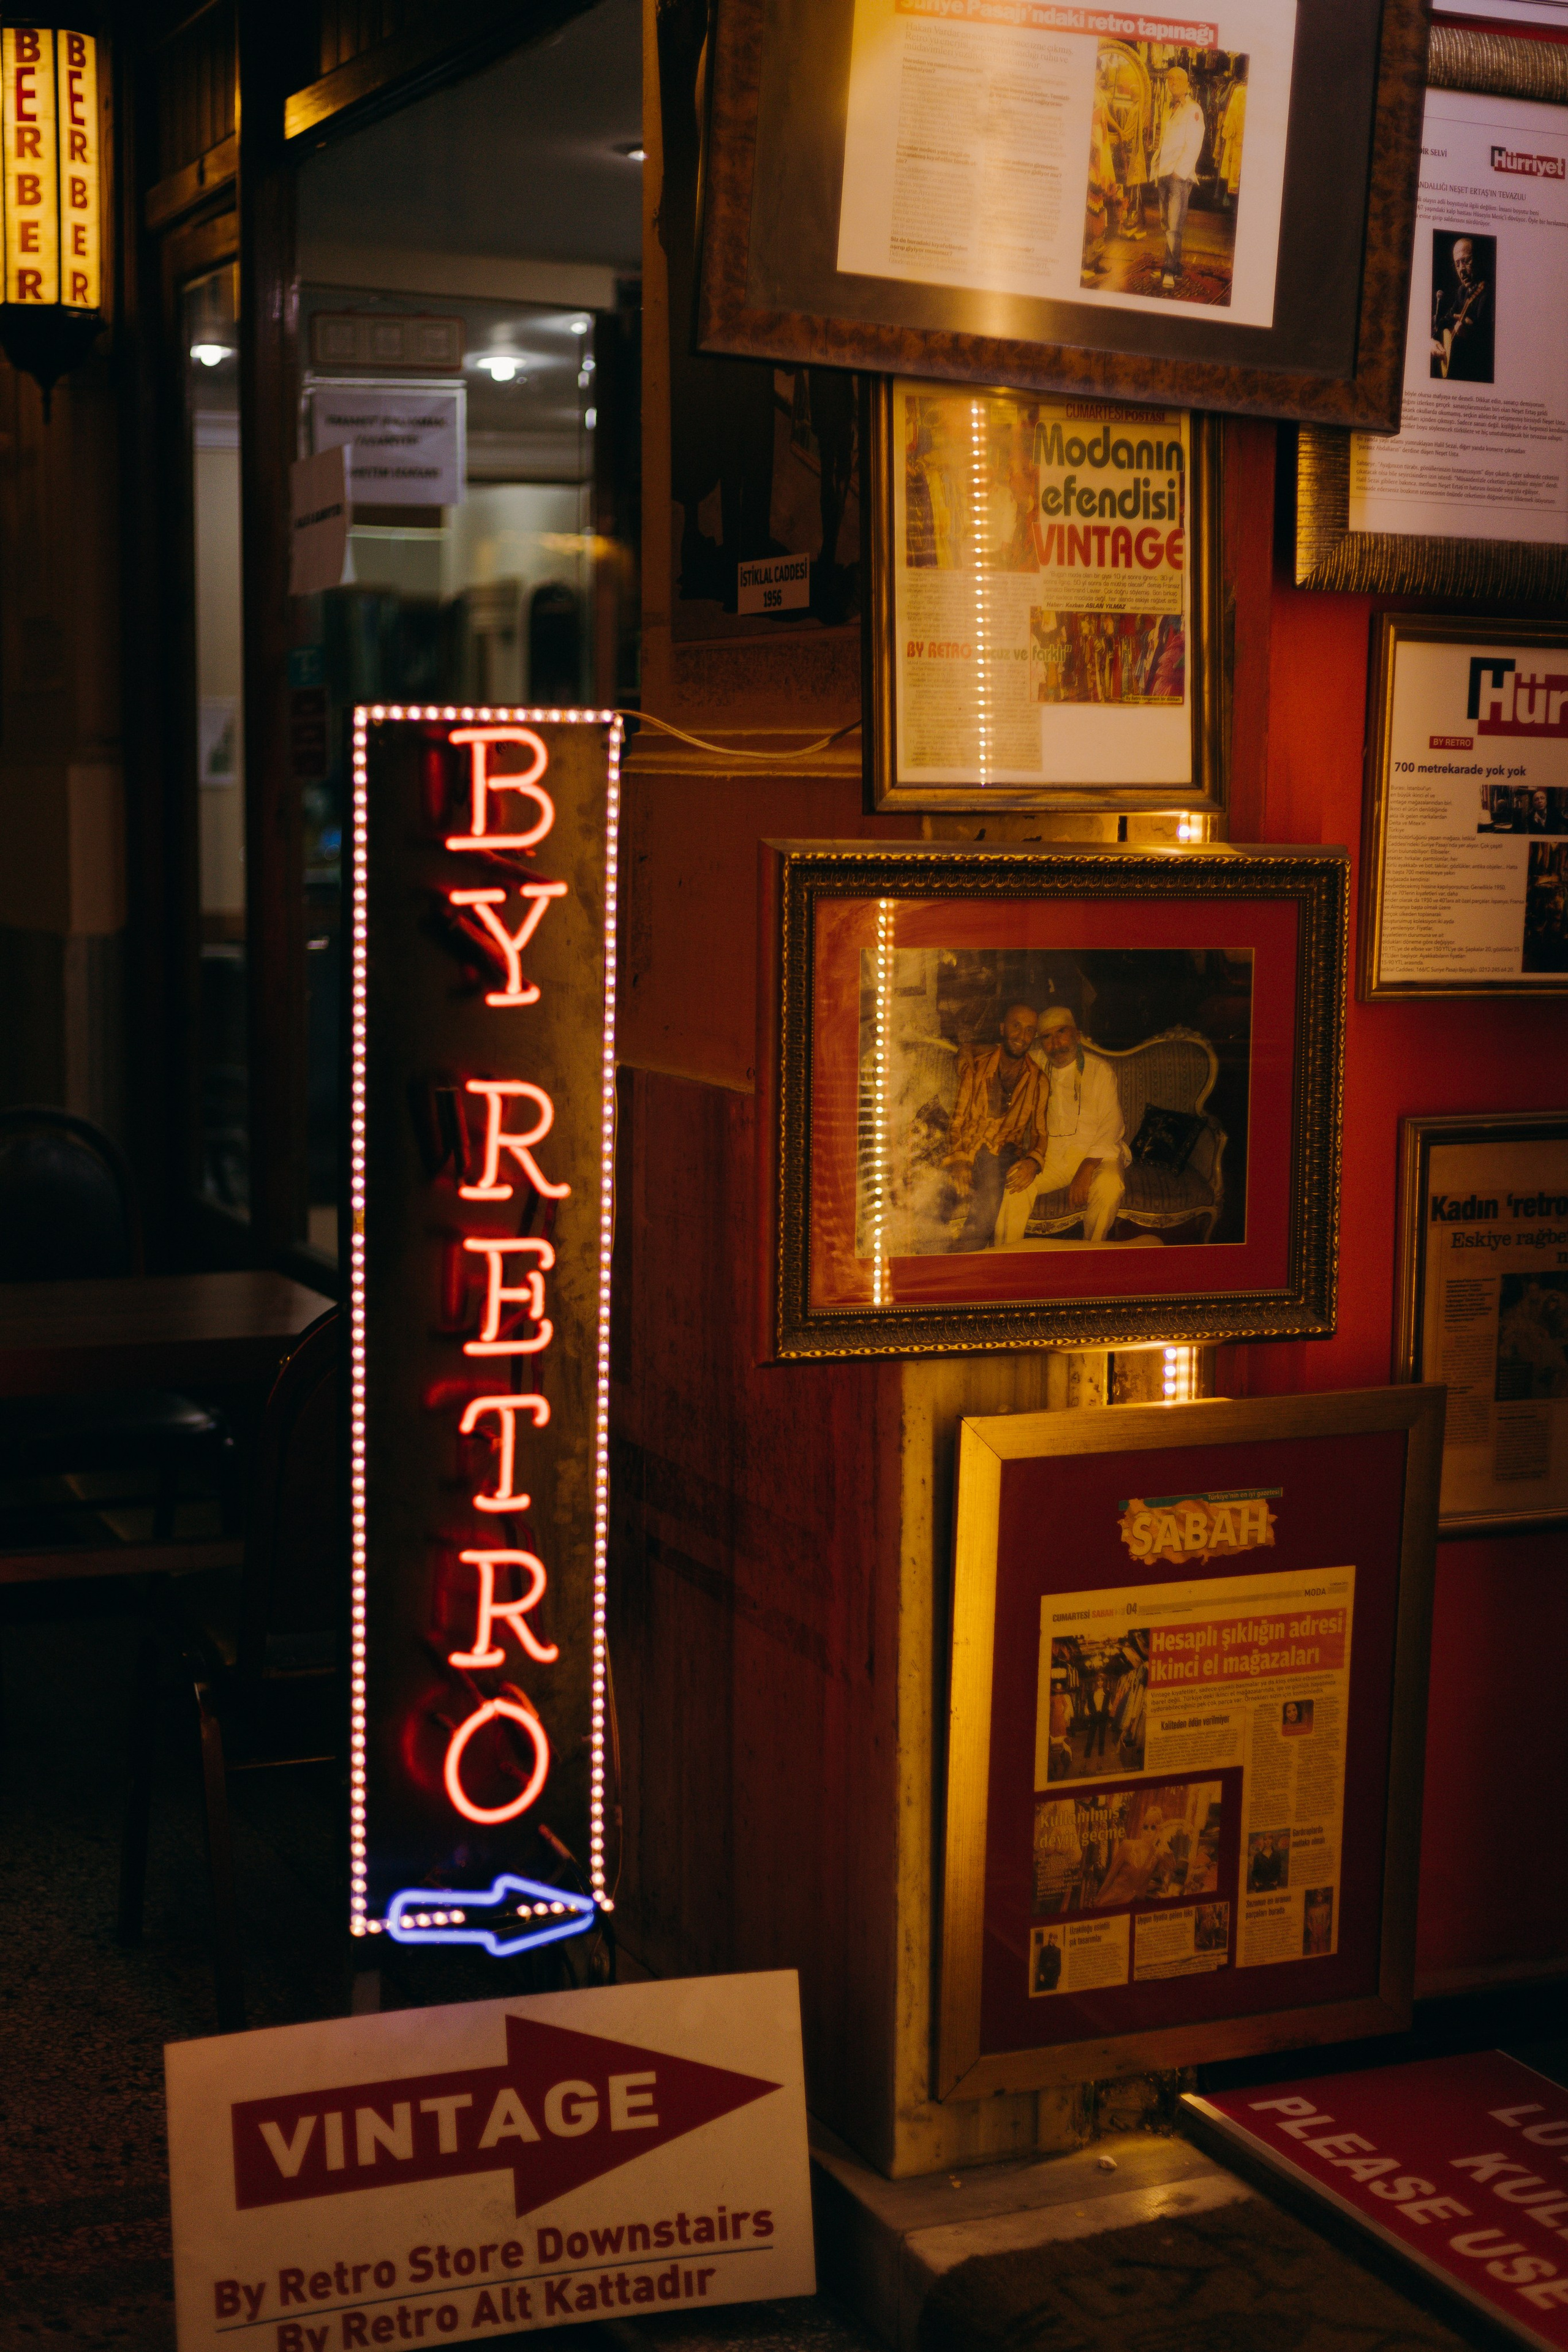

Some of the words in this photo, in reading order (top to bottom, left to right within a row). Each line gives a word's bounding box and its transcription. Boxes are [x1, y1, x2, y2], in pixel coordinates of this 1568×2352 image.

[906, 22, 931, 33] Hakan
[934, 26, 960, 38] Vardar
[1088, 13, 1134, 33] retro
[1137, 18, 1214, 45] tapınağı
[1430, 148, 1447, 157] SELVİ
[1493, 149, 1565, 177] Hürriyet
[1417, 182, 1448, 193] NDALLIĞI
[1449, 184, 1468, 195] NEŞET
[1446, 207, 1456, 216] kalp
[1473, 209, 1491, 219] Hüseyin
[1065, 404, 1123, 421] CUMARTESİ
[1033, 421, 1185, 472] Modanın
[1041, 475, 1176, 521] efendisi
[1032, 522, 1184, 570] VINTAGE
[740, 564, 774, 588] İSTİKLAL
[774, 557, 808, 582] CADDESİ
[763, 590, 782, 608] 1956
[907, 641, 924, 658] BY
[928, 643, 972, 660] RETRO
[1013, 649, 1028, 661] ve
[1394, 762, 1415, 772] 700
[1417, 763, 1483, 774] metrekarade
[1485, 765, 1504, 778] yok
[1507, 766, 1526, 778] yok
[445, 726, 568, 1008] BY
[1431, 1194, 1498, 1222] Kadın
[1450, 1231, 1512, 1251] Eskiye
[1515, 1228, 1568, 1250] rağbe
[442, 1079, 572, 1823] RETRO
[1207, 1492, 1239, 1501] Türkiye'nin
[1257, 1489, 1280, 1499] gazetesi
[1130, 1506, 1267, 1556] SABAH
[1052, 1608, 1091, 1623] CUMARTESİ
[1125, 1602, 1138, 1616] 04
[1304, 1588, 1326, 1597] MODA
[1151, 1626, 1218, 1654] Hesaplı
[1221, 1617, 1286, 1651] şıklığın
[1288, 1610, 1344, 1638] adresi
[1150, 1657, 1200, 1683] ikinci
[1202, 1656, 1219, 1678] el
[1223, 1645, 1320, 1676] mağazaları
[1150, 1690, 1171, 1699] Vintage
[1197, 1700, 1206, 1709] pek
[1161, 1719, 1187, 1732] Kaliteden
[1188, 1717, 1202, 1728] ödün
[1202, 1714, 1231, 1727] verilmiyor
[257, 2070, 659, 2179] VINTAGE
[1247, 2096, 1475, 2225] PLEASE
[1449, 2228, 1568, 2310] USE
[213, 2278, 266, 2323] By
[279, 2259, 396, 2307] Retro
[409, 2238, 524, 2283] Store
[537, 2206, 774, 2265] Downstairs
[341, 2301, 459, 2351] Retro
[471, 2285, 532, 2328] Alt
[545, 2264, 717, 2317] Kattadır
